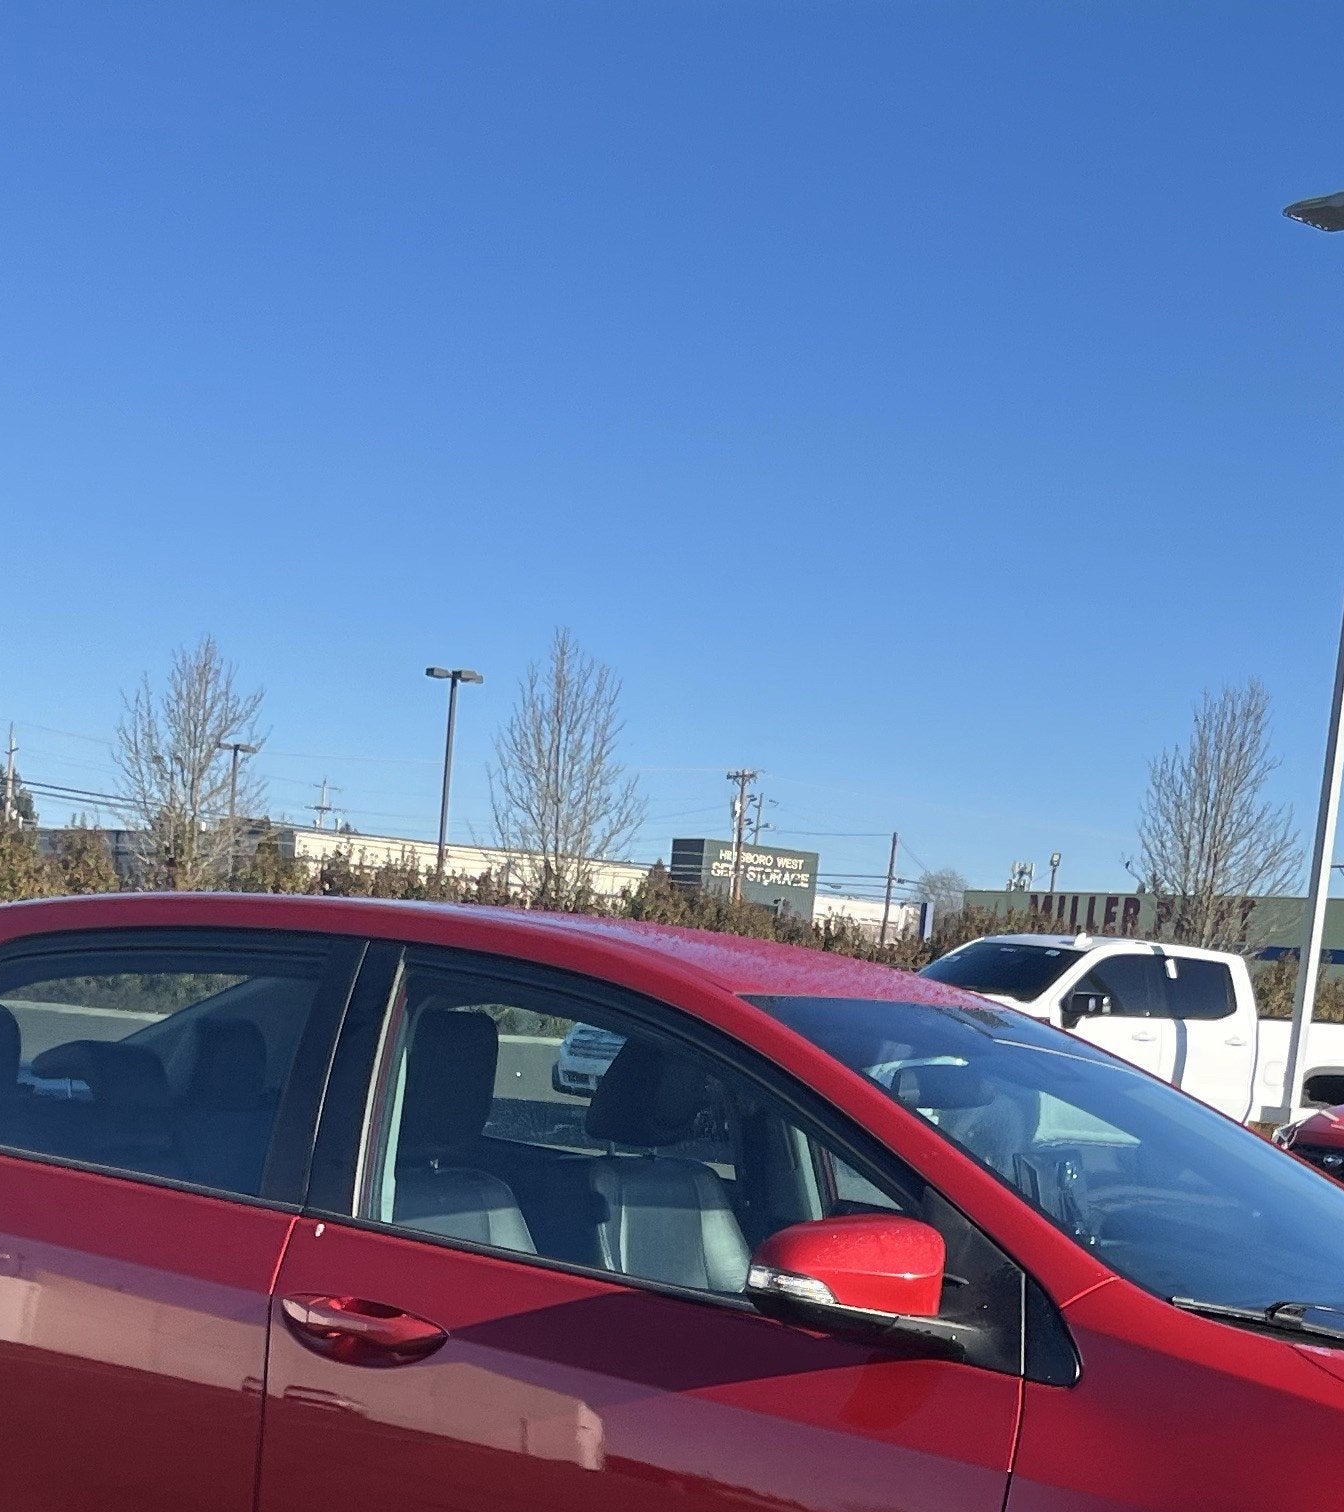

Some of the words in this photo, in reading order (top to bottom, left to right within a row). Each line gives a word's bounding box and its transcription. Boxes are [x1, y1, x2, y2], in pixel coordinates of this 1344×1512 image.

[776, 856, 805, 870] WEST
[746, 865, 810, 888] STORAGE
[1029, 894, 1141, 938] MILLER
